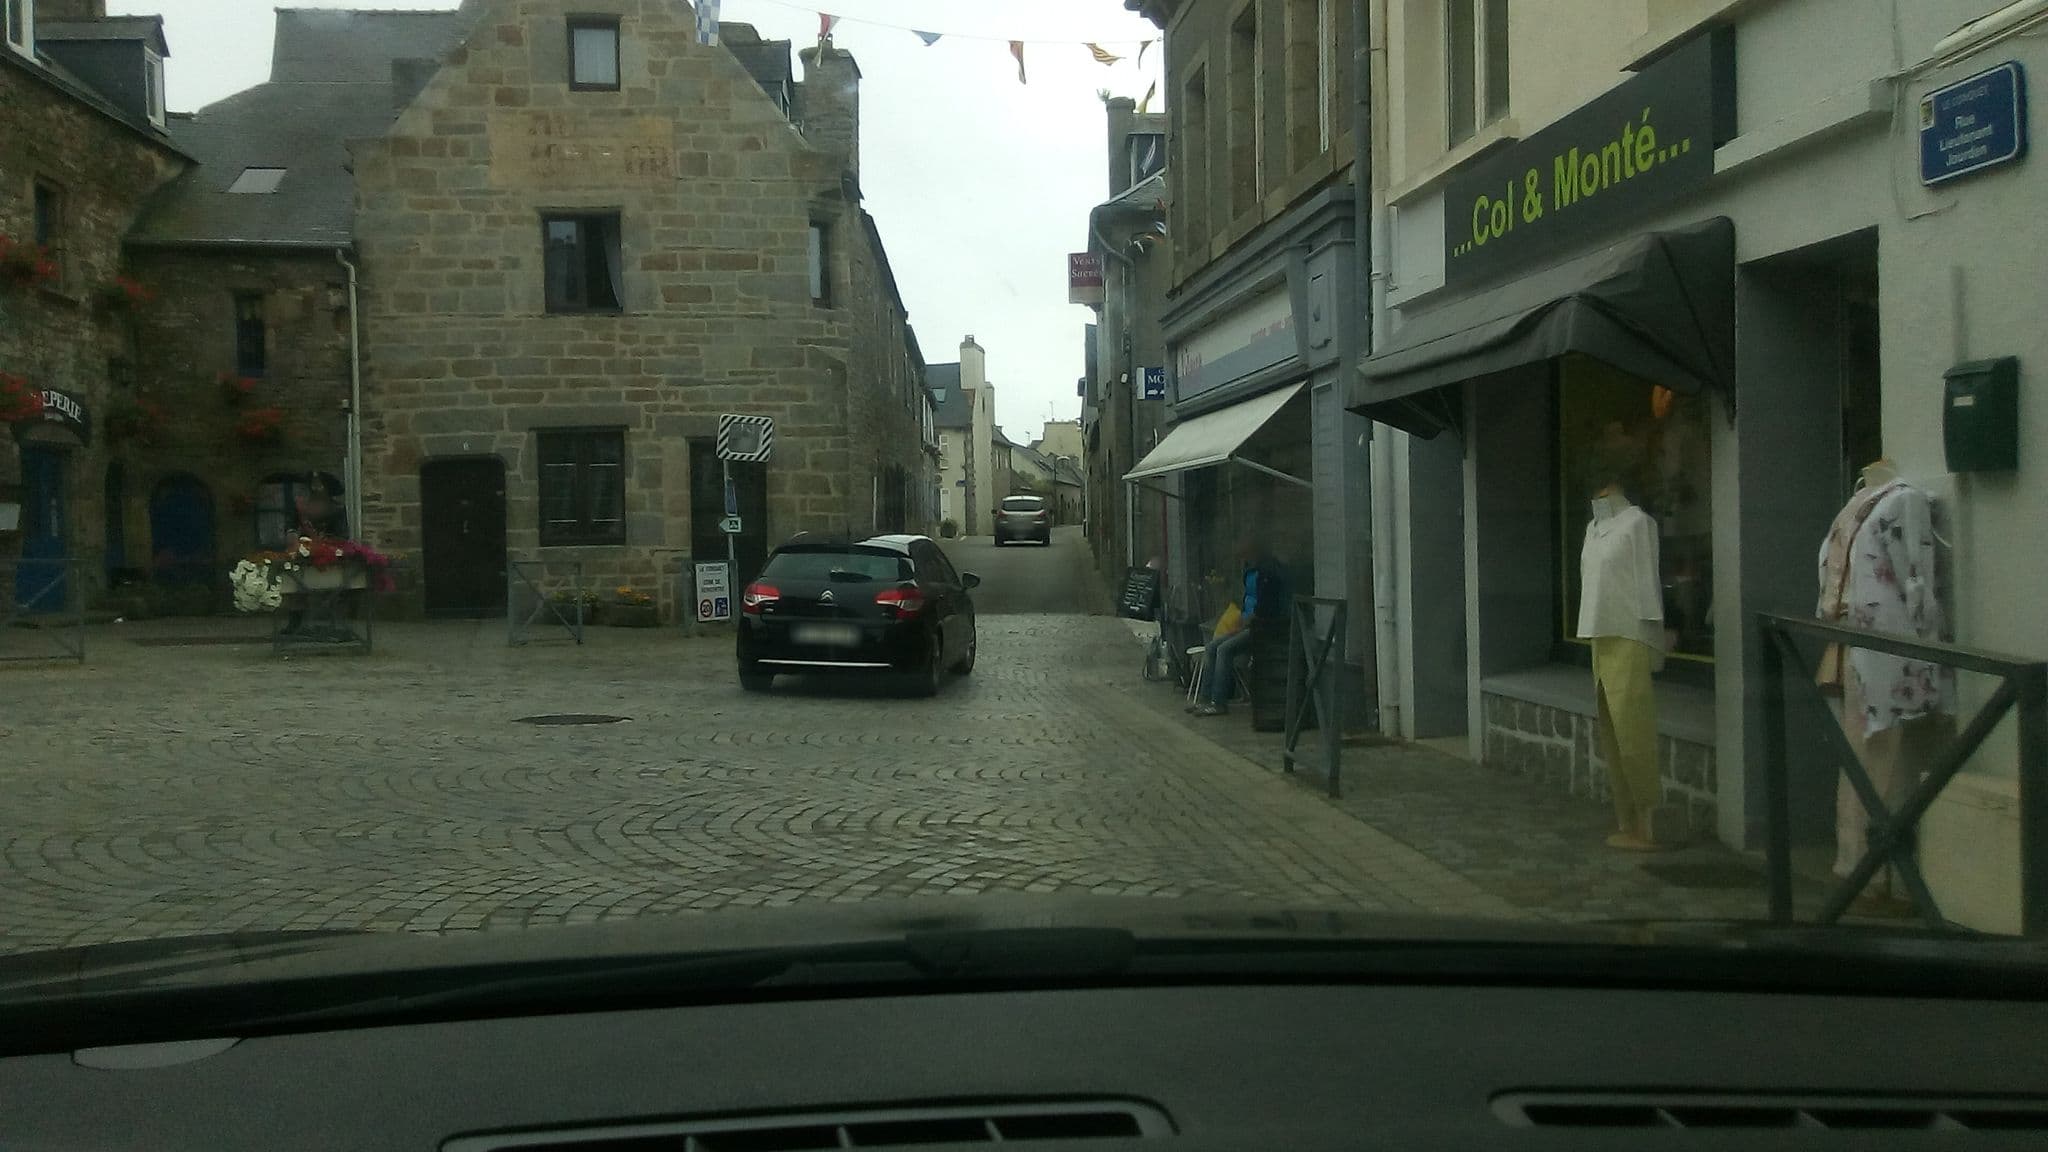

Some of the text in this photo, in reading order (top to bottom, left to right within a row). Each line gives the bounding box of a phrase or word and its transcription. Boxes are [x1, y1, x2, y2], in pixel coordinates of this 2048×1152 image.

[1954, 114, 1976, 129] Rue
[1522, 168, 1543, 224] &
[1553, 107, 1691, 212] Monté...
